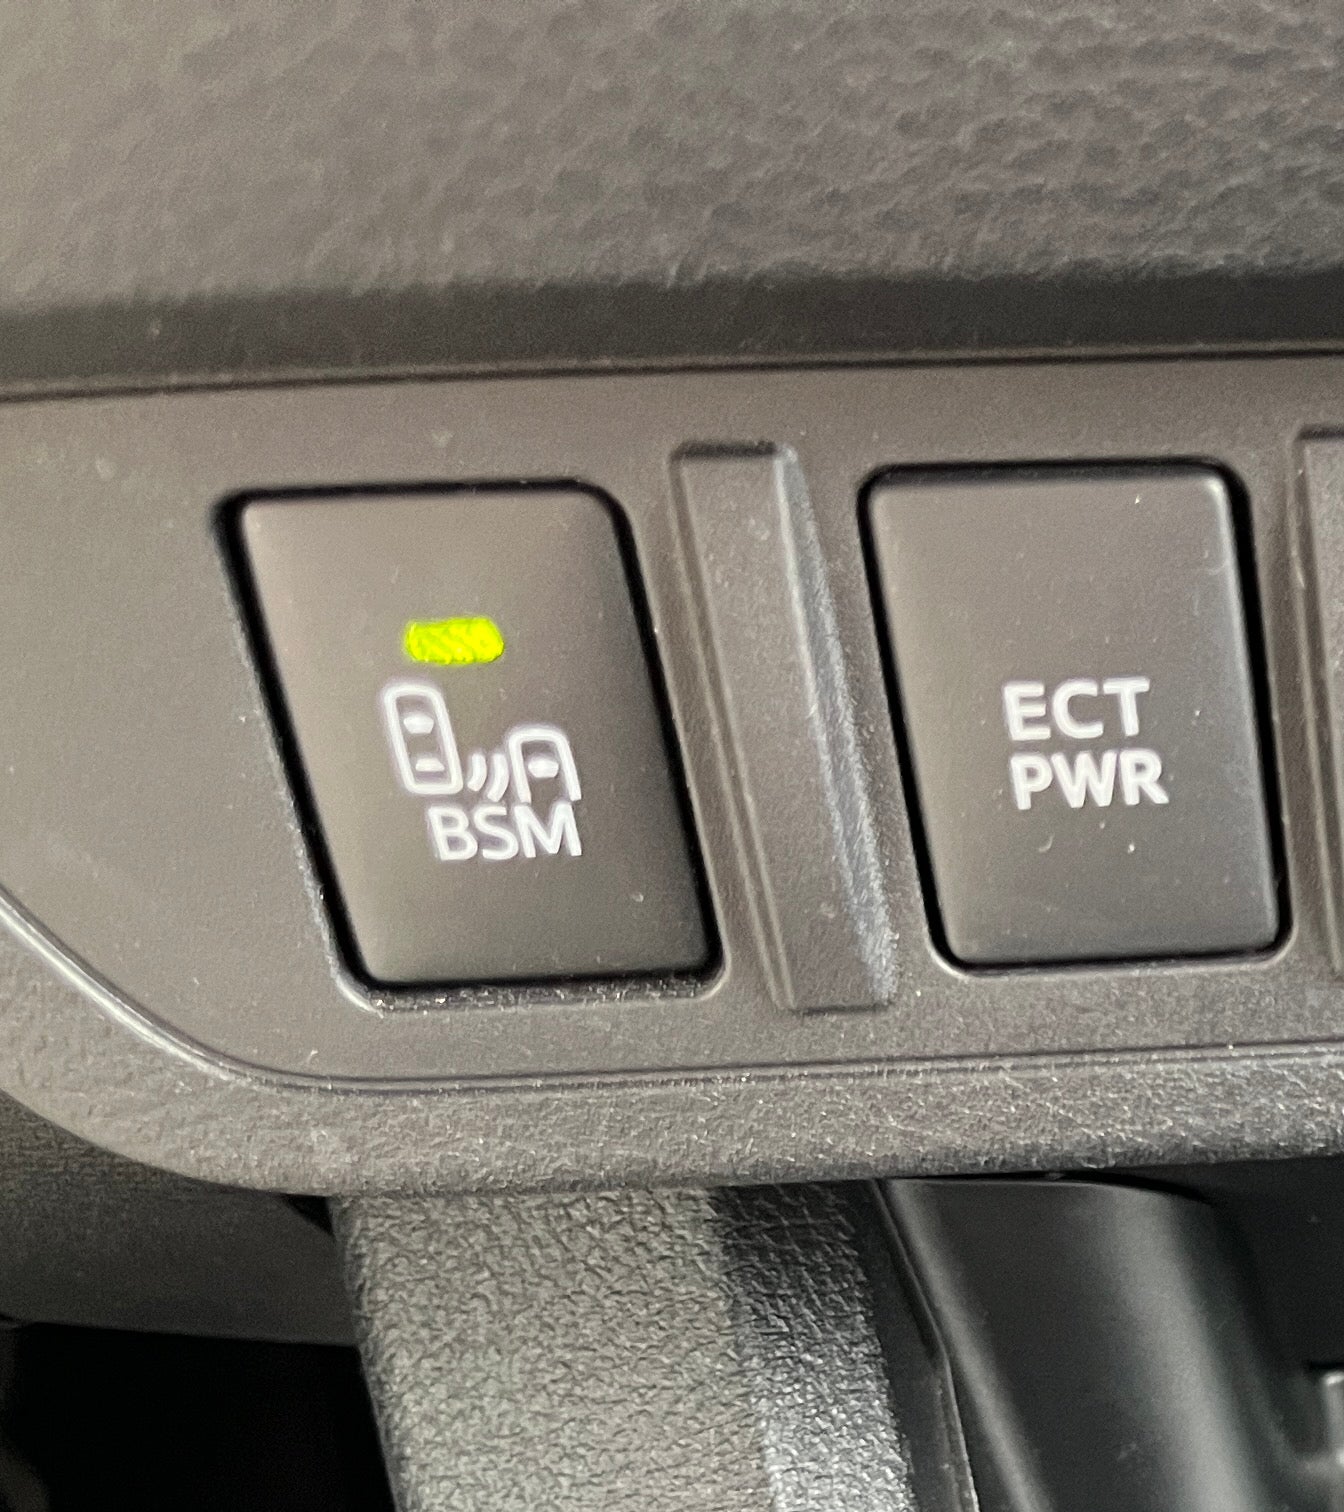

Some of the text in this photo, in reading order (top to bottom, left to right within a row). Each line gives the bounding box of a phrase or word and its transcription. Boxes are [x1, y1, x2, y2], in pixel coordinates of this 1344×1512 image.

[1004, 676, 1150, 742] ECT
[1009, 752, 1170, 811] PWR
[428, 803, 582, 862] BSM
